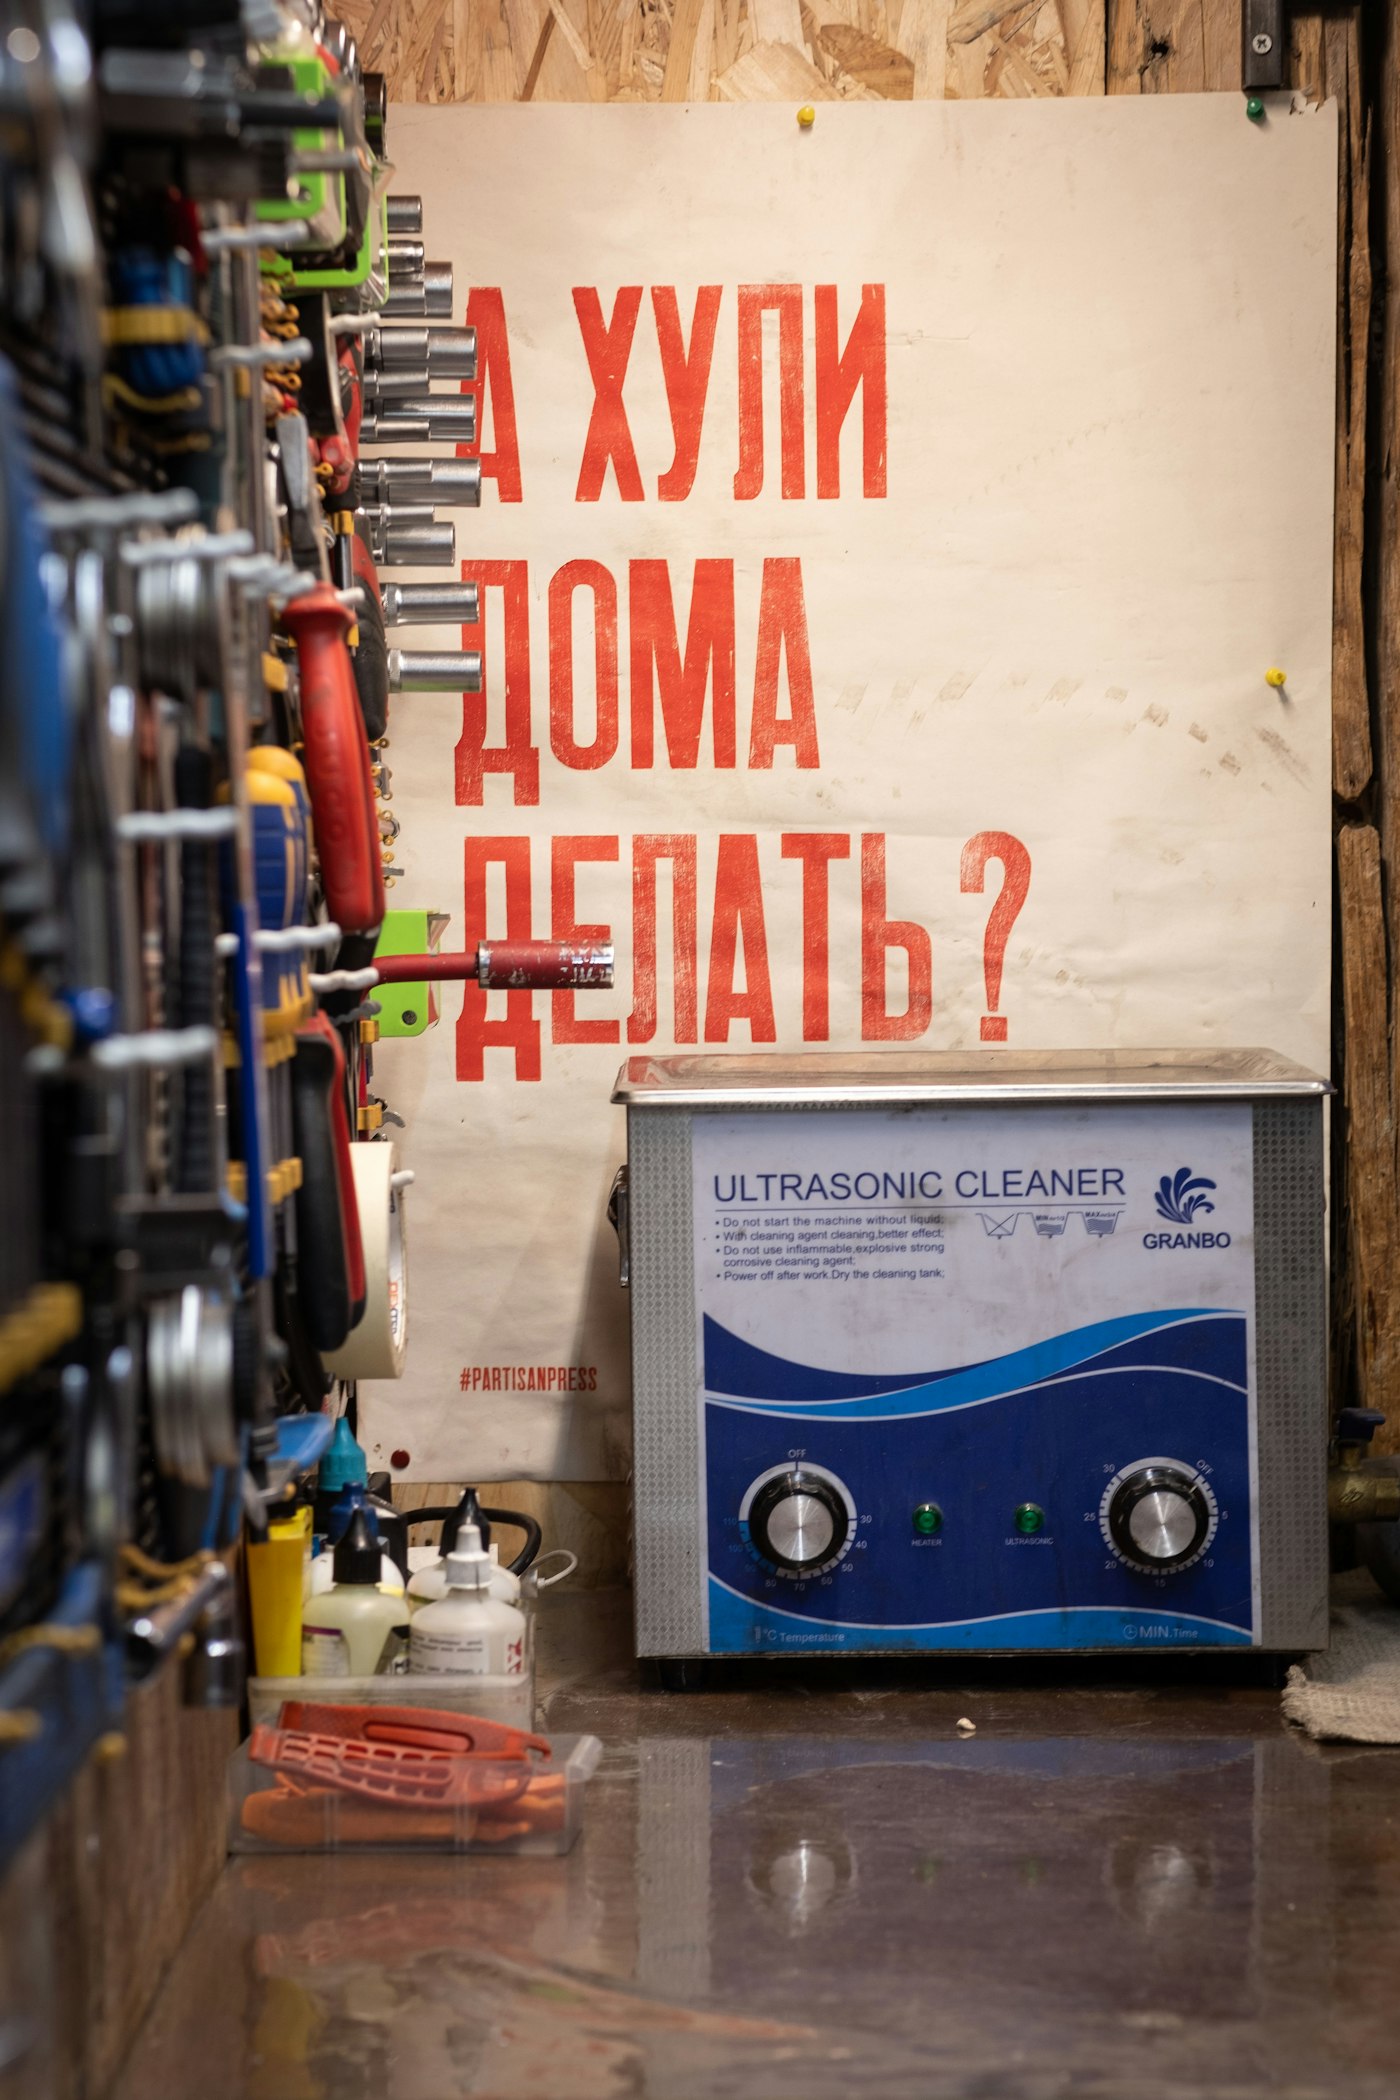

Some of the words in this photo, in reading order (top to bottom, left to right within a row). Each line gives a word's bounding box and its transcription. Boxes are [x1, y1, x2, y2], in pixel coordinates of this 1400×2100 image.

[455, 286, 522, 502] А
[571, 283, 887, 502] ХУЛИ
[455, 556, 820, 806] ДОМА
[714, 1171, 943, 1202] ULTRASONIC
[955, 1168, 1126, 1198] CLEANER
[723, 1217, 739, 1227] Do
[743, 1218, 760, 1226] not
[764, 1217, 789, 1226] start
[793, 1217, 810, 1226] the
[814, 1216, 862, 1226] machine
[866, 1215, 906, 1224] without
[723, 1231, 747, 1241] With
[750, 1230, 794, 1242] cleaning
[798, 1230, 828, 1242] agent
[1142, 1232, 1231, 1249] GRANBO
[723, 1245, 739, 1255] Do
[742, 1246, 760, 1254] not
[910, 1243, 944, 1254] strong
[723, 1257, 772, 1267] corrosive
[775, 1256, 820, 1268] cleaning
[724, 1271, 757, 1280] Power
[760, 1271, 774, 1280] off
[777, 1270, 800, 1280] after
[853, 1269, 869, 1279] the
[872, 1268, 917, 1280] cleaning
[459, 1366, 598, 1391] #PARTISANPRESS
[788, 1449, 806, 1458] OFF
[1103, 1464, 1115, 1473] 30
[1196, 1459, 1213, 1475] OFF
[860, 1514, 872, 1523] 30
[1084, 1513, 1096, 1522] 25
[1222, 1511, 1228, 1520] 5
[855, 1541, 867, 1549] 40
[912, 1538, 942, 1547] HEATER
[1005, 1537, 1054, 1546] ULTRASONIC
[1105, 1561, 1117, 1570] 20
[1203, 1559, 1214, 1568] 10
[794, 1583, 805, 1591] 70
[1154, 1579, 1165, 1588] 15
[780, 1632, 845, 1643] Temperature
